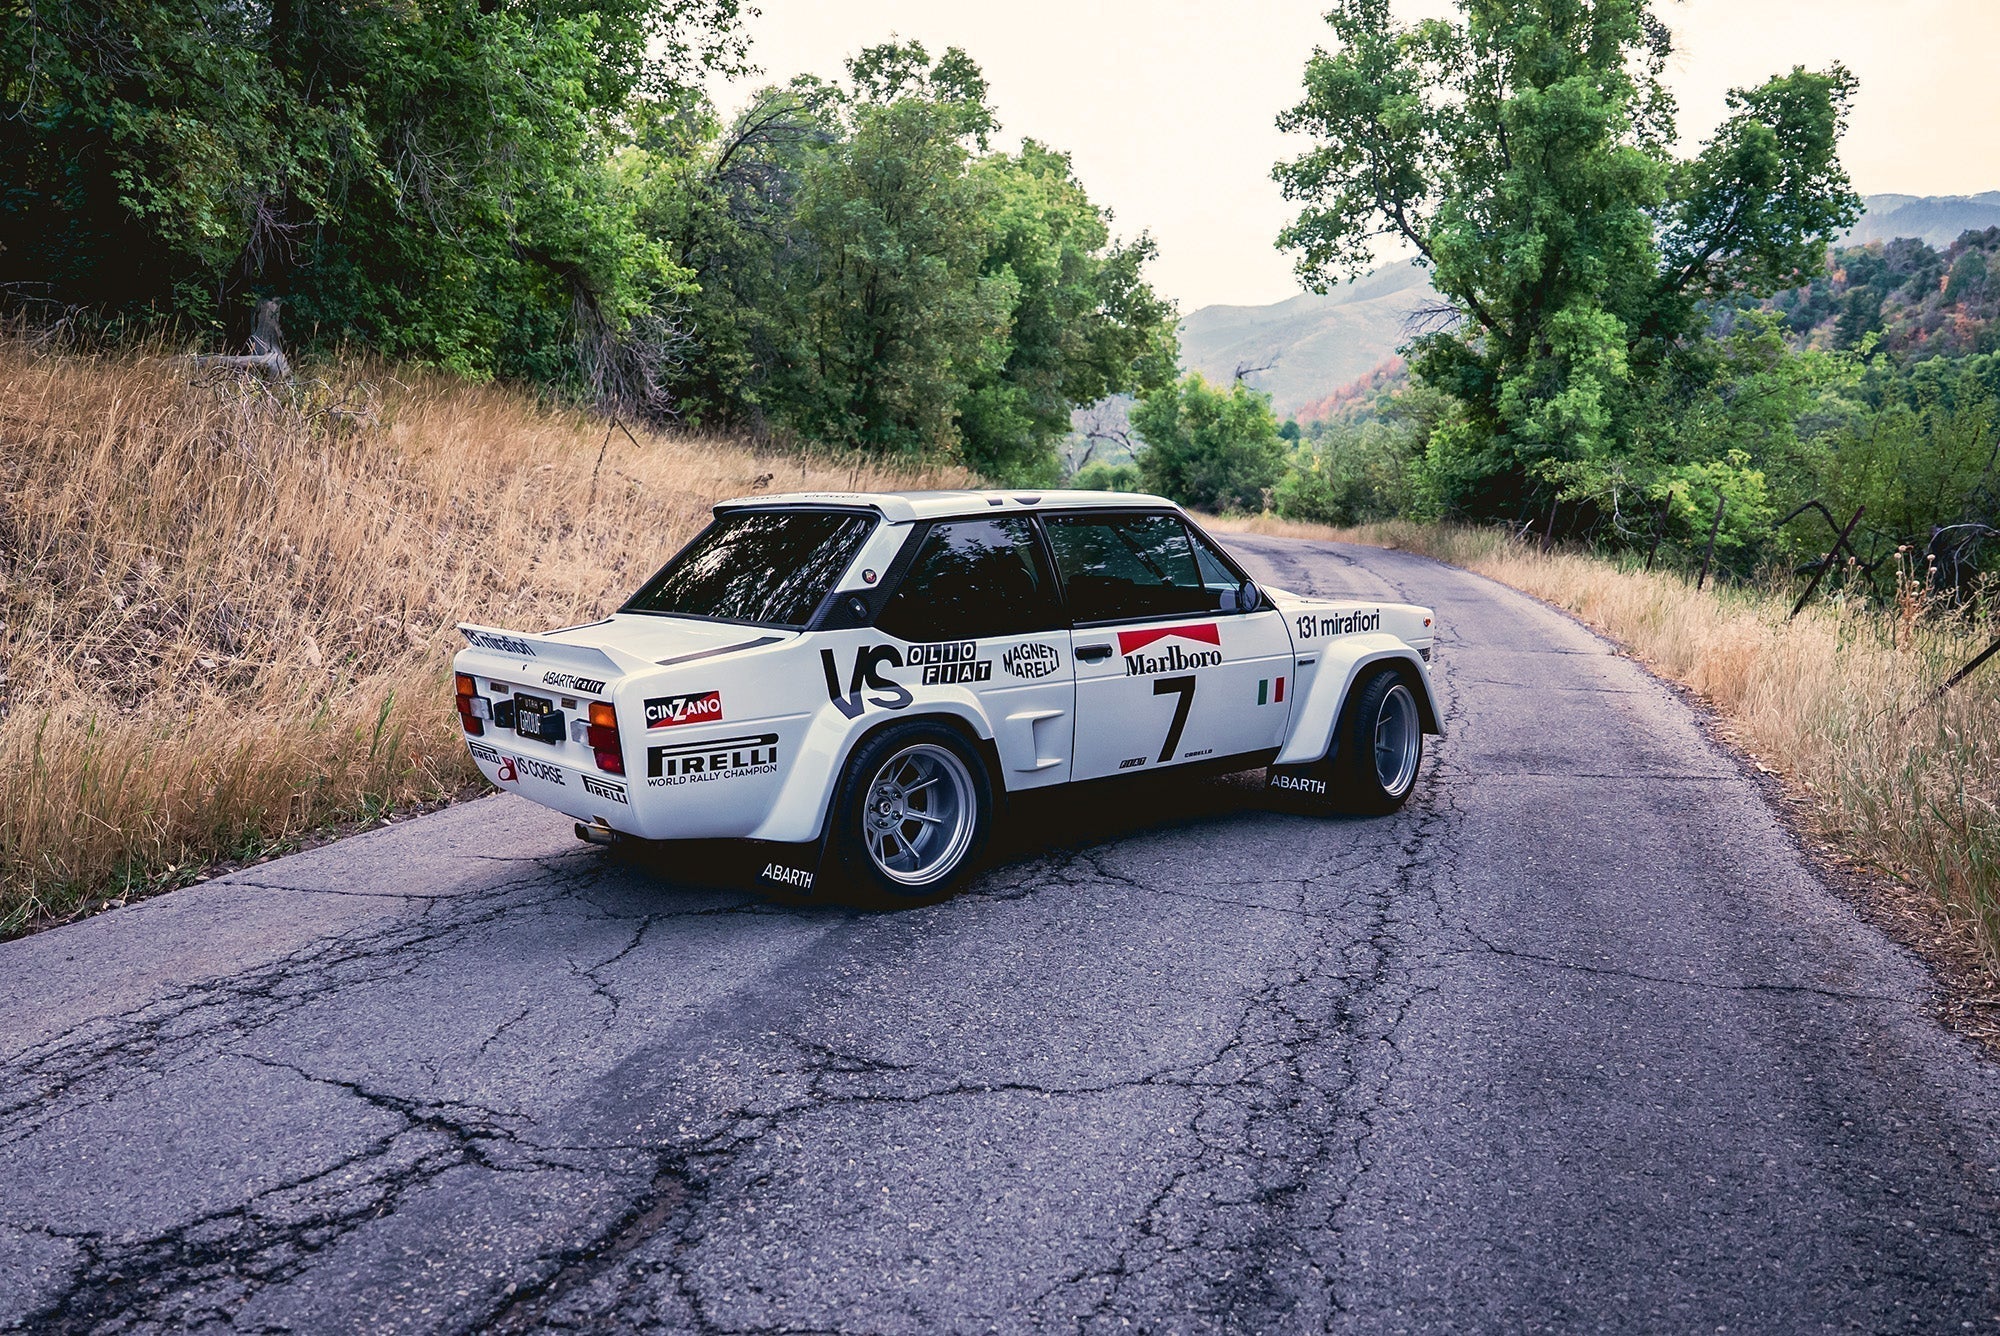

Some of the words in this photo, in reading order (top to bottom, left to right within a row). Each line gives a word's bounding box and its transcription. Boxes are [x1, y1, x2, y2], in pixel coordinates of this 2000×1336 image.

[1296, 615, 1318, 639] 131
[1321, 608, 1380, 636] mirafiori
[480, 632, 537, 657] mirafiori
[908, 642, 976, 665] OLIO
[1124, 645, 1222, 676] Marlboro
[542, 671, 579, 689] ABARTH
[819, 644, 914, 720] VS
[925, 663, 990, 684] FIAT
[645, 698, 721, 722] CINZANO
[1153, 675, 1196, 763] 7
[469, 741, 501, 765] PIRELLI
[647, 733, 779, 778] PIRELLI
[1119, 757, 1147, 769] FIAT
[513, 755, 529, 774] VS
[528, 759, 566, 786] CORSE
[647, 776, 687, 788] WORLD
[690, 771, 721, 784] RALLY
[723, 764, 777, 779] CHAMPION
[581, 775, 629, 805] PIRELLI
[1270, 774, 1326, 794] ABARTH
[761, 863, 814, 889] ABARTH
